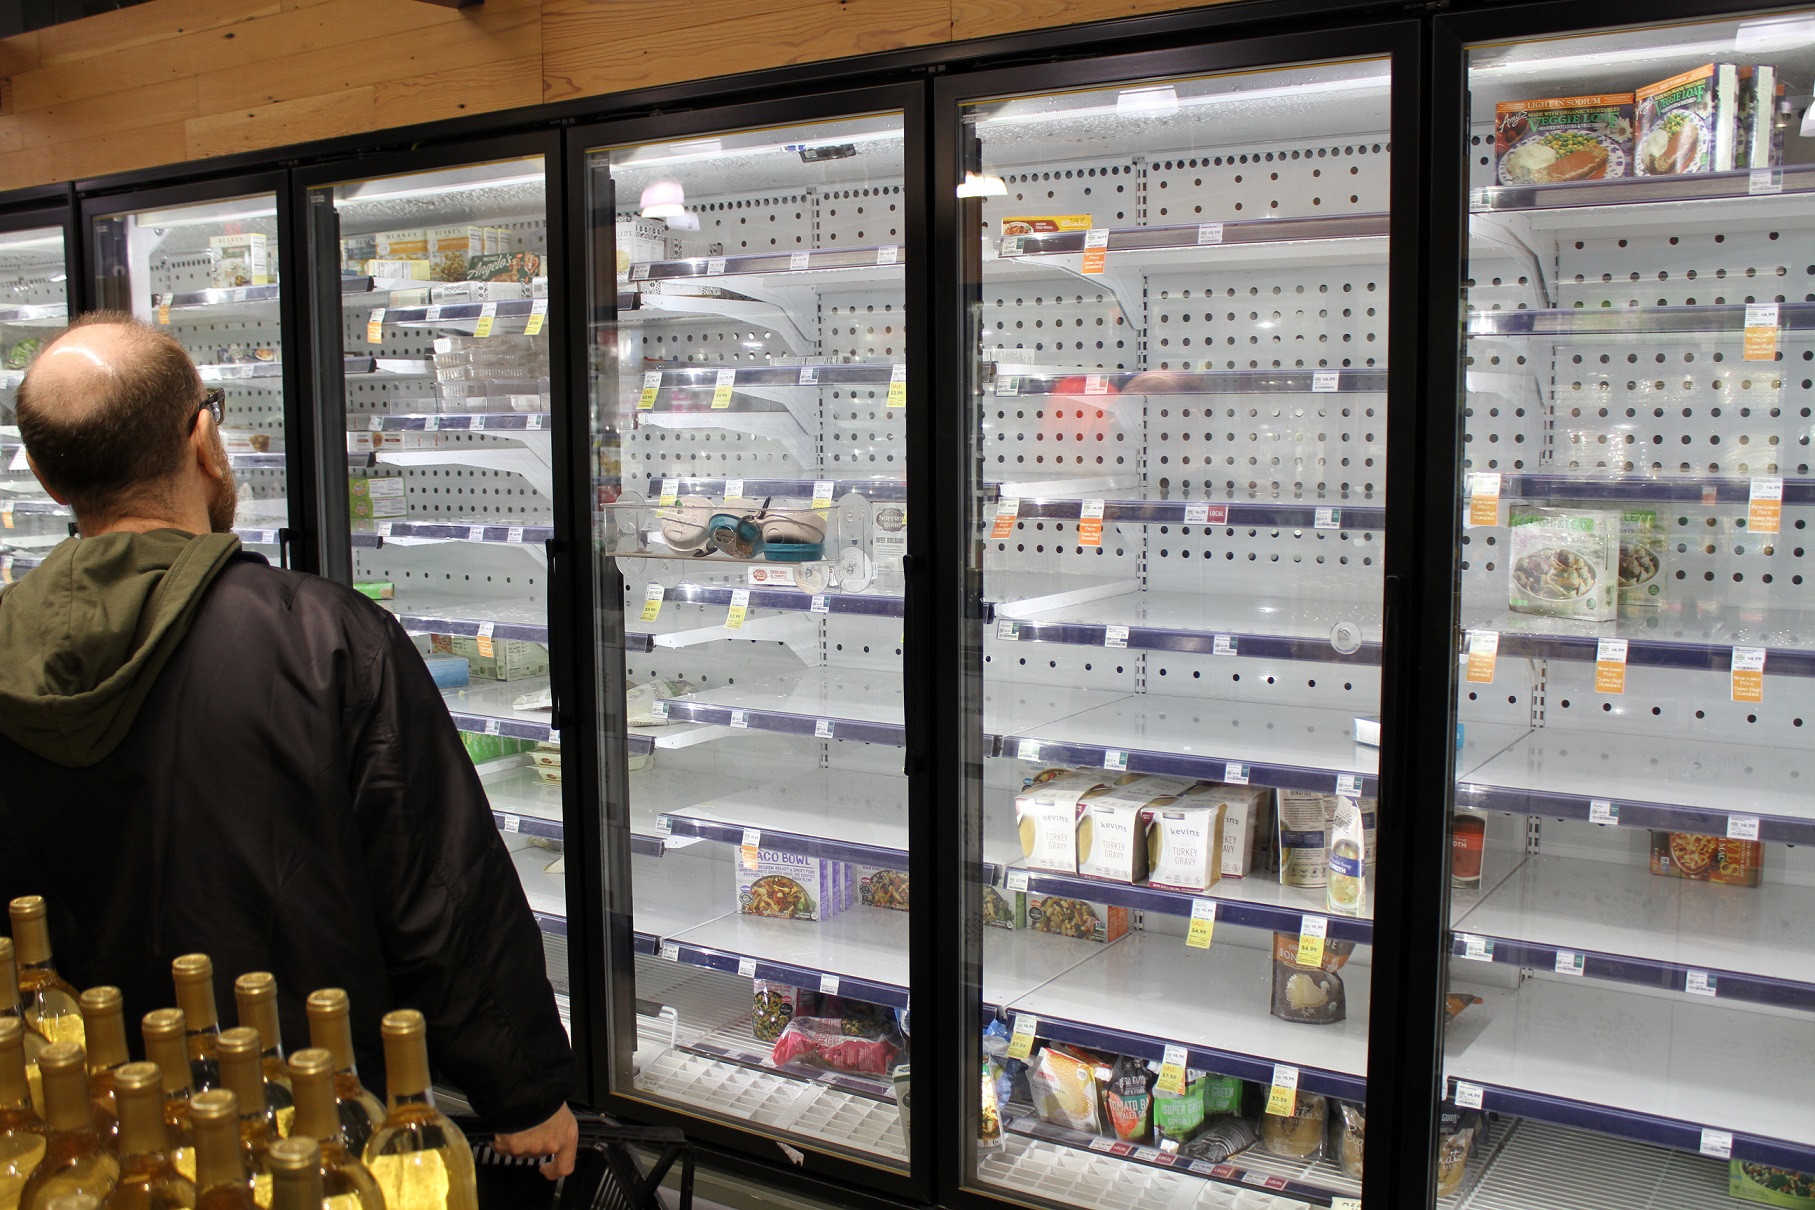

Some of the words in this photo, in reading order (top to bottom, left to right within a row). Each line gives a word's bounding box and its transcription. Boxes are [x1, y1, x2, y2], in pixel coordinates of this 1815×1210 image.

[1528, 100, 1552, 108] LIGHT
[1567, 97, 1601, 106] SODIUM
[1654, 92, 1681, 116] VEGGIE
[1682, 85, 1706, 102] LOAF
[1528, 115, 1580, 132] VEGGIE
[468, 254, 512, 279] Angelo's
[1042, 814, 1068, 822] kevin's
[1225, 816, 1239, 825] in's
[1101, 822, 1128, 832] kevin's
[1046, 832, 1068, 842] TURKEY
[1170, 828, 1200, 837] kevin's
[1048, 842, 1067, 851] GRAVY
[1103, 840, 1125, 851] TURKEY
[1223, 844, 1234, 853] AVY
[1105, 850, 1123, 860] GRAVY
[1173, 847, 1198, 857] TURKEY
[1718, 842, 1726, 861] MAC
[757, 851, 779, 862] ACO
[782, 853, 810, 865] BOWL
[1175, 857, 1197, 866] GRAVY
[1720, 838, 1740, 876] WLS
[1279, 948, 1298, 962] BON
[1212, 1087, 1234, 1097] GREEN
[1110, 1098, 1137, 1112] TOMATO
[1163, 1105, 1186, 1115] SUPER
[1214, 1166, 1228, 1174] LOCAL
